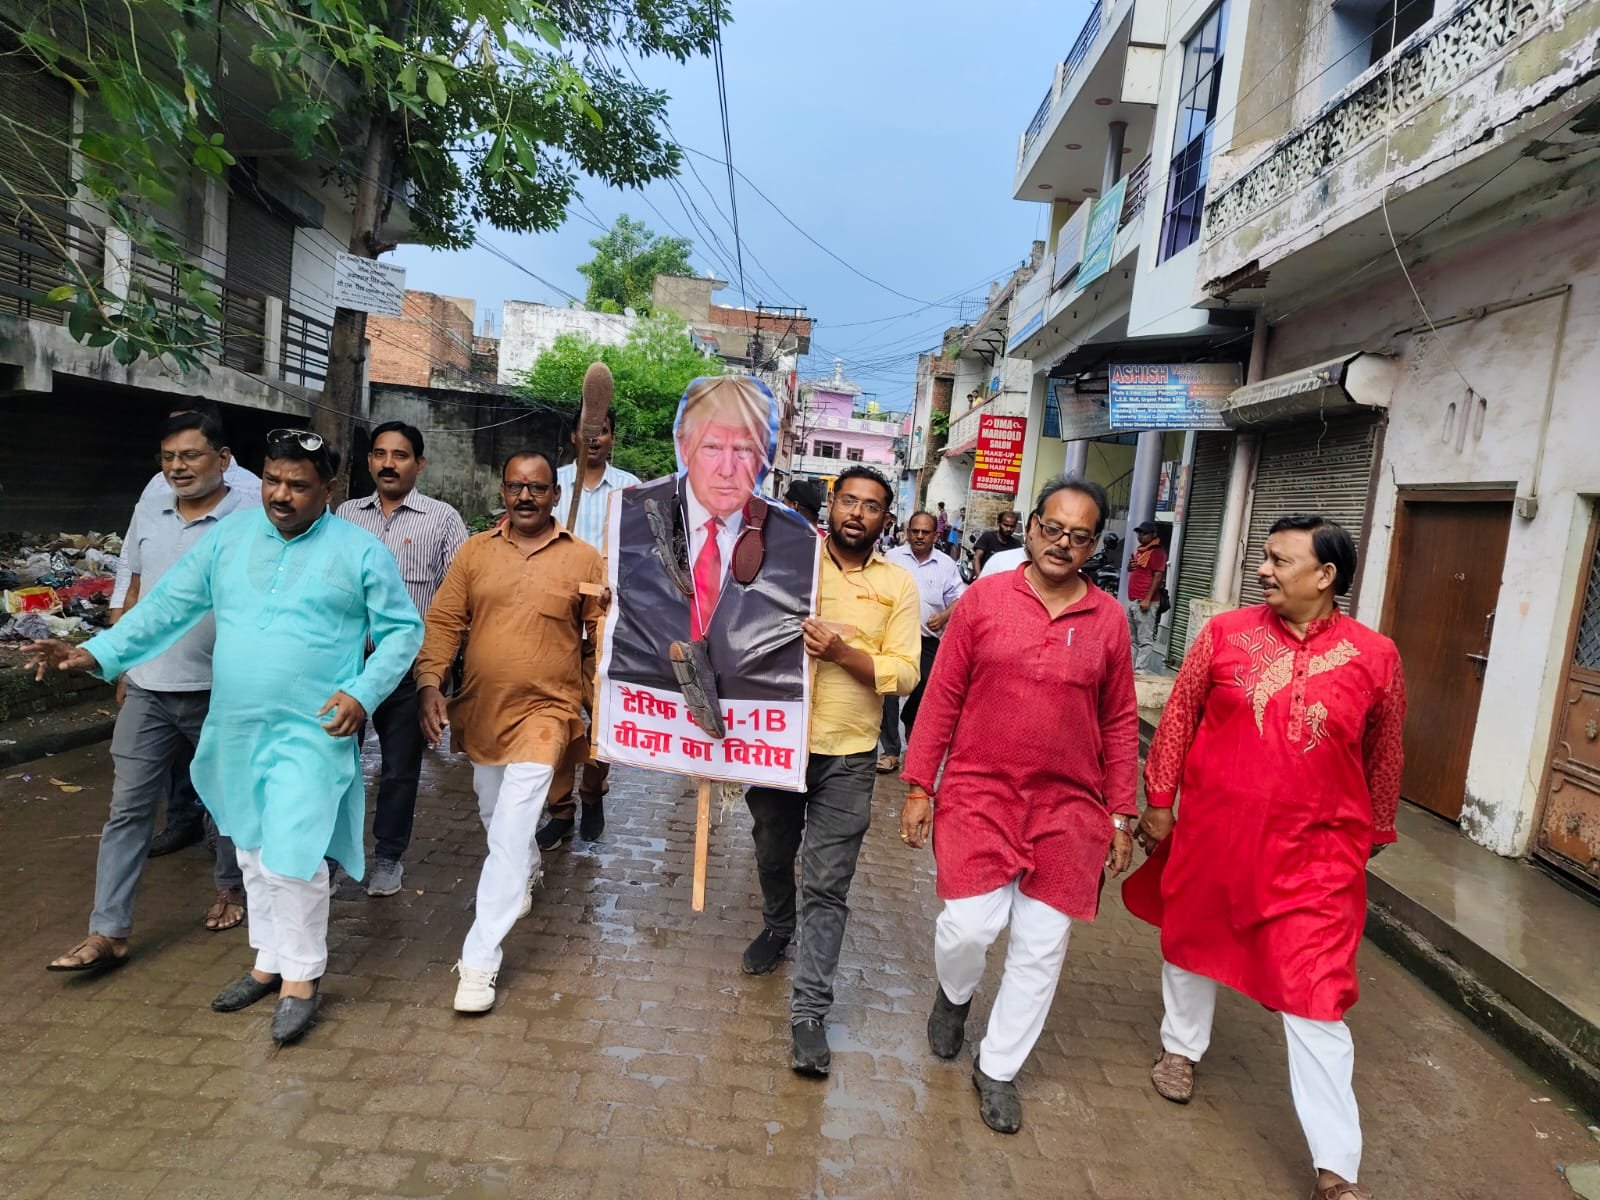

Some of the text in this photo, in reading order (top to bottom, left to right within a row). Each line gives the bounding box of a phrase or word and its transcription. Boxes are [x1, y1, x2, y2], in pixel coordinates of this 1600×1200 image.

[1112, 366, 1168, 384] ASHISH
[993, 419, 1012, 429] UMA
[981, 428, 1022, 441] MARIGOLD
[989, 440, 1012, 449] SALON
[983, 449, 1014, 458] MAKE-UP
[984, 457, 1012, 465] BEAUTY
[617, 685, 678, 720] टैरिफ
[613, 720, 795, 769] वीज़ा का विरोध
